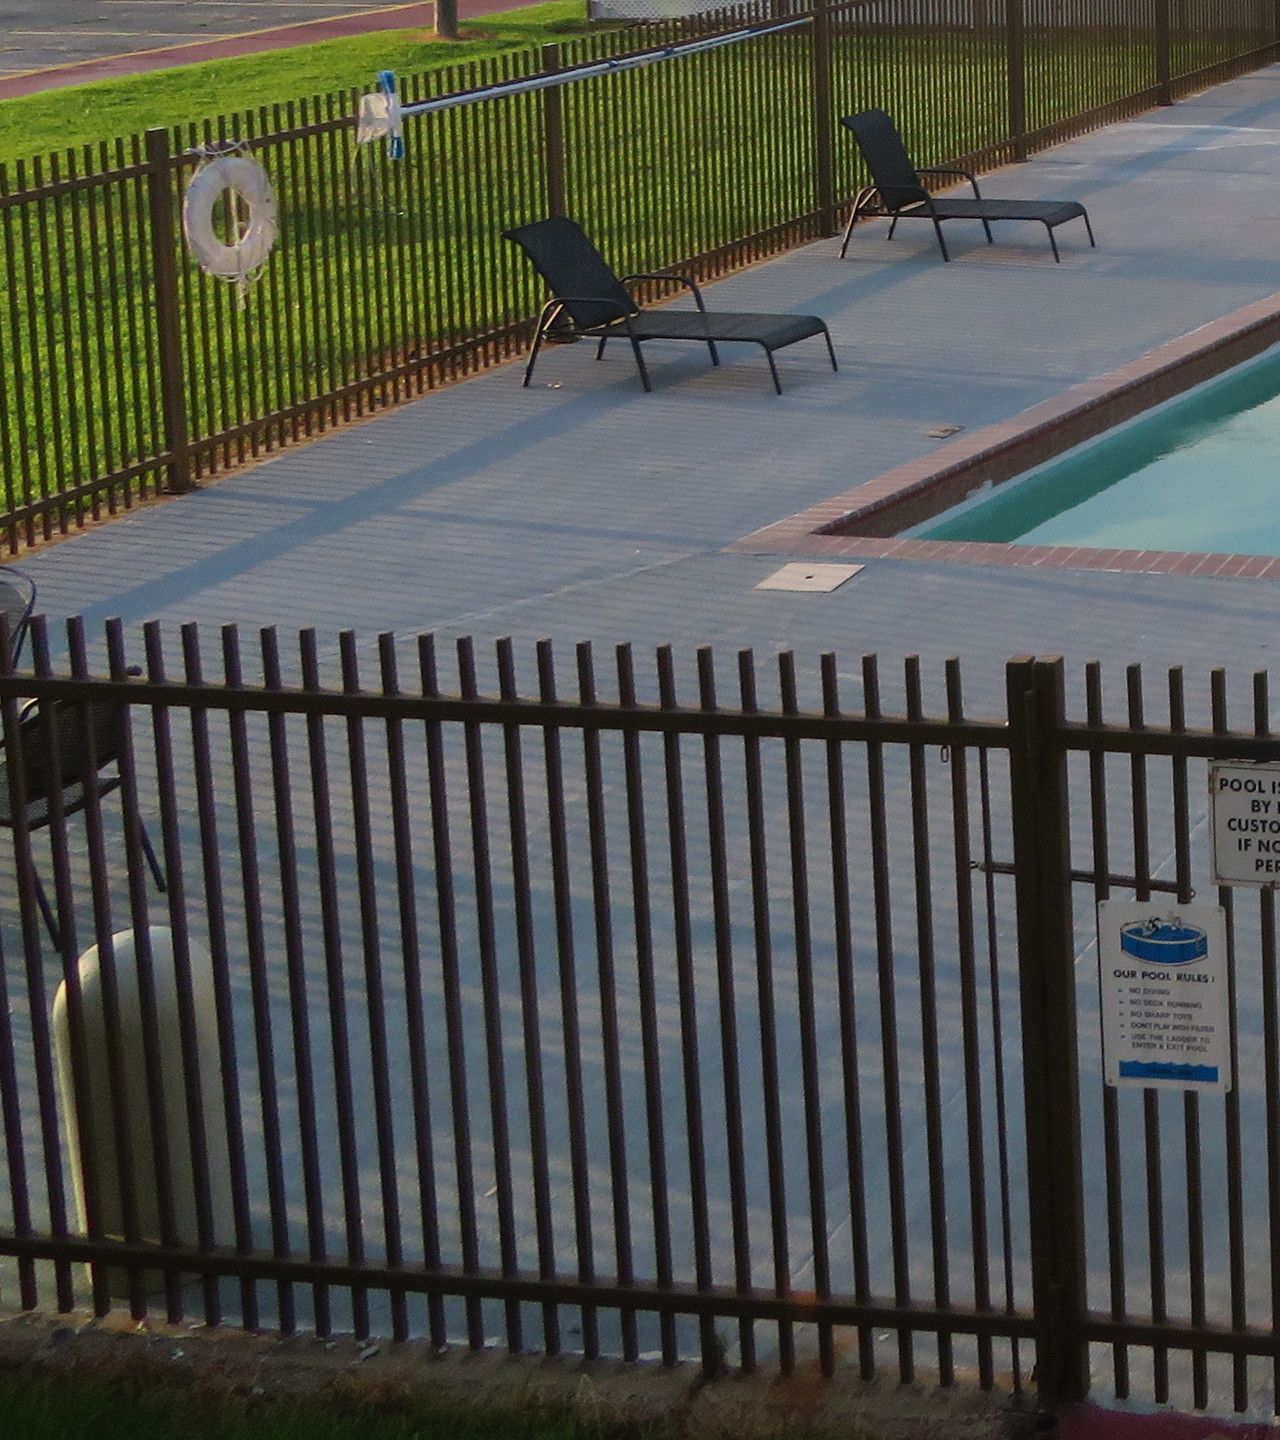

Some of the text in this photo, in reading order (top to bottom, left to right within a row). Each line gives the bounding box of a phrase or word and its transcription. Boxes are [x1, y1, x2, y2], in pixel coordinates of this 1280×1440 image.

[1219, 778, 1266, 794] POOL
[1251, 799, 1272, 813] BY
[1238, 838, 1253, 852] IF
[1113, 969, 1137, 979] OUR
[1141, 971, 1171, 981] POOL
[1142, 988, 1170, 996] DIVING
